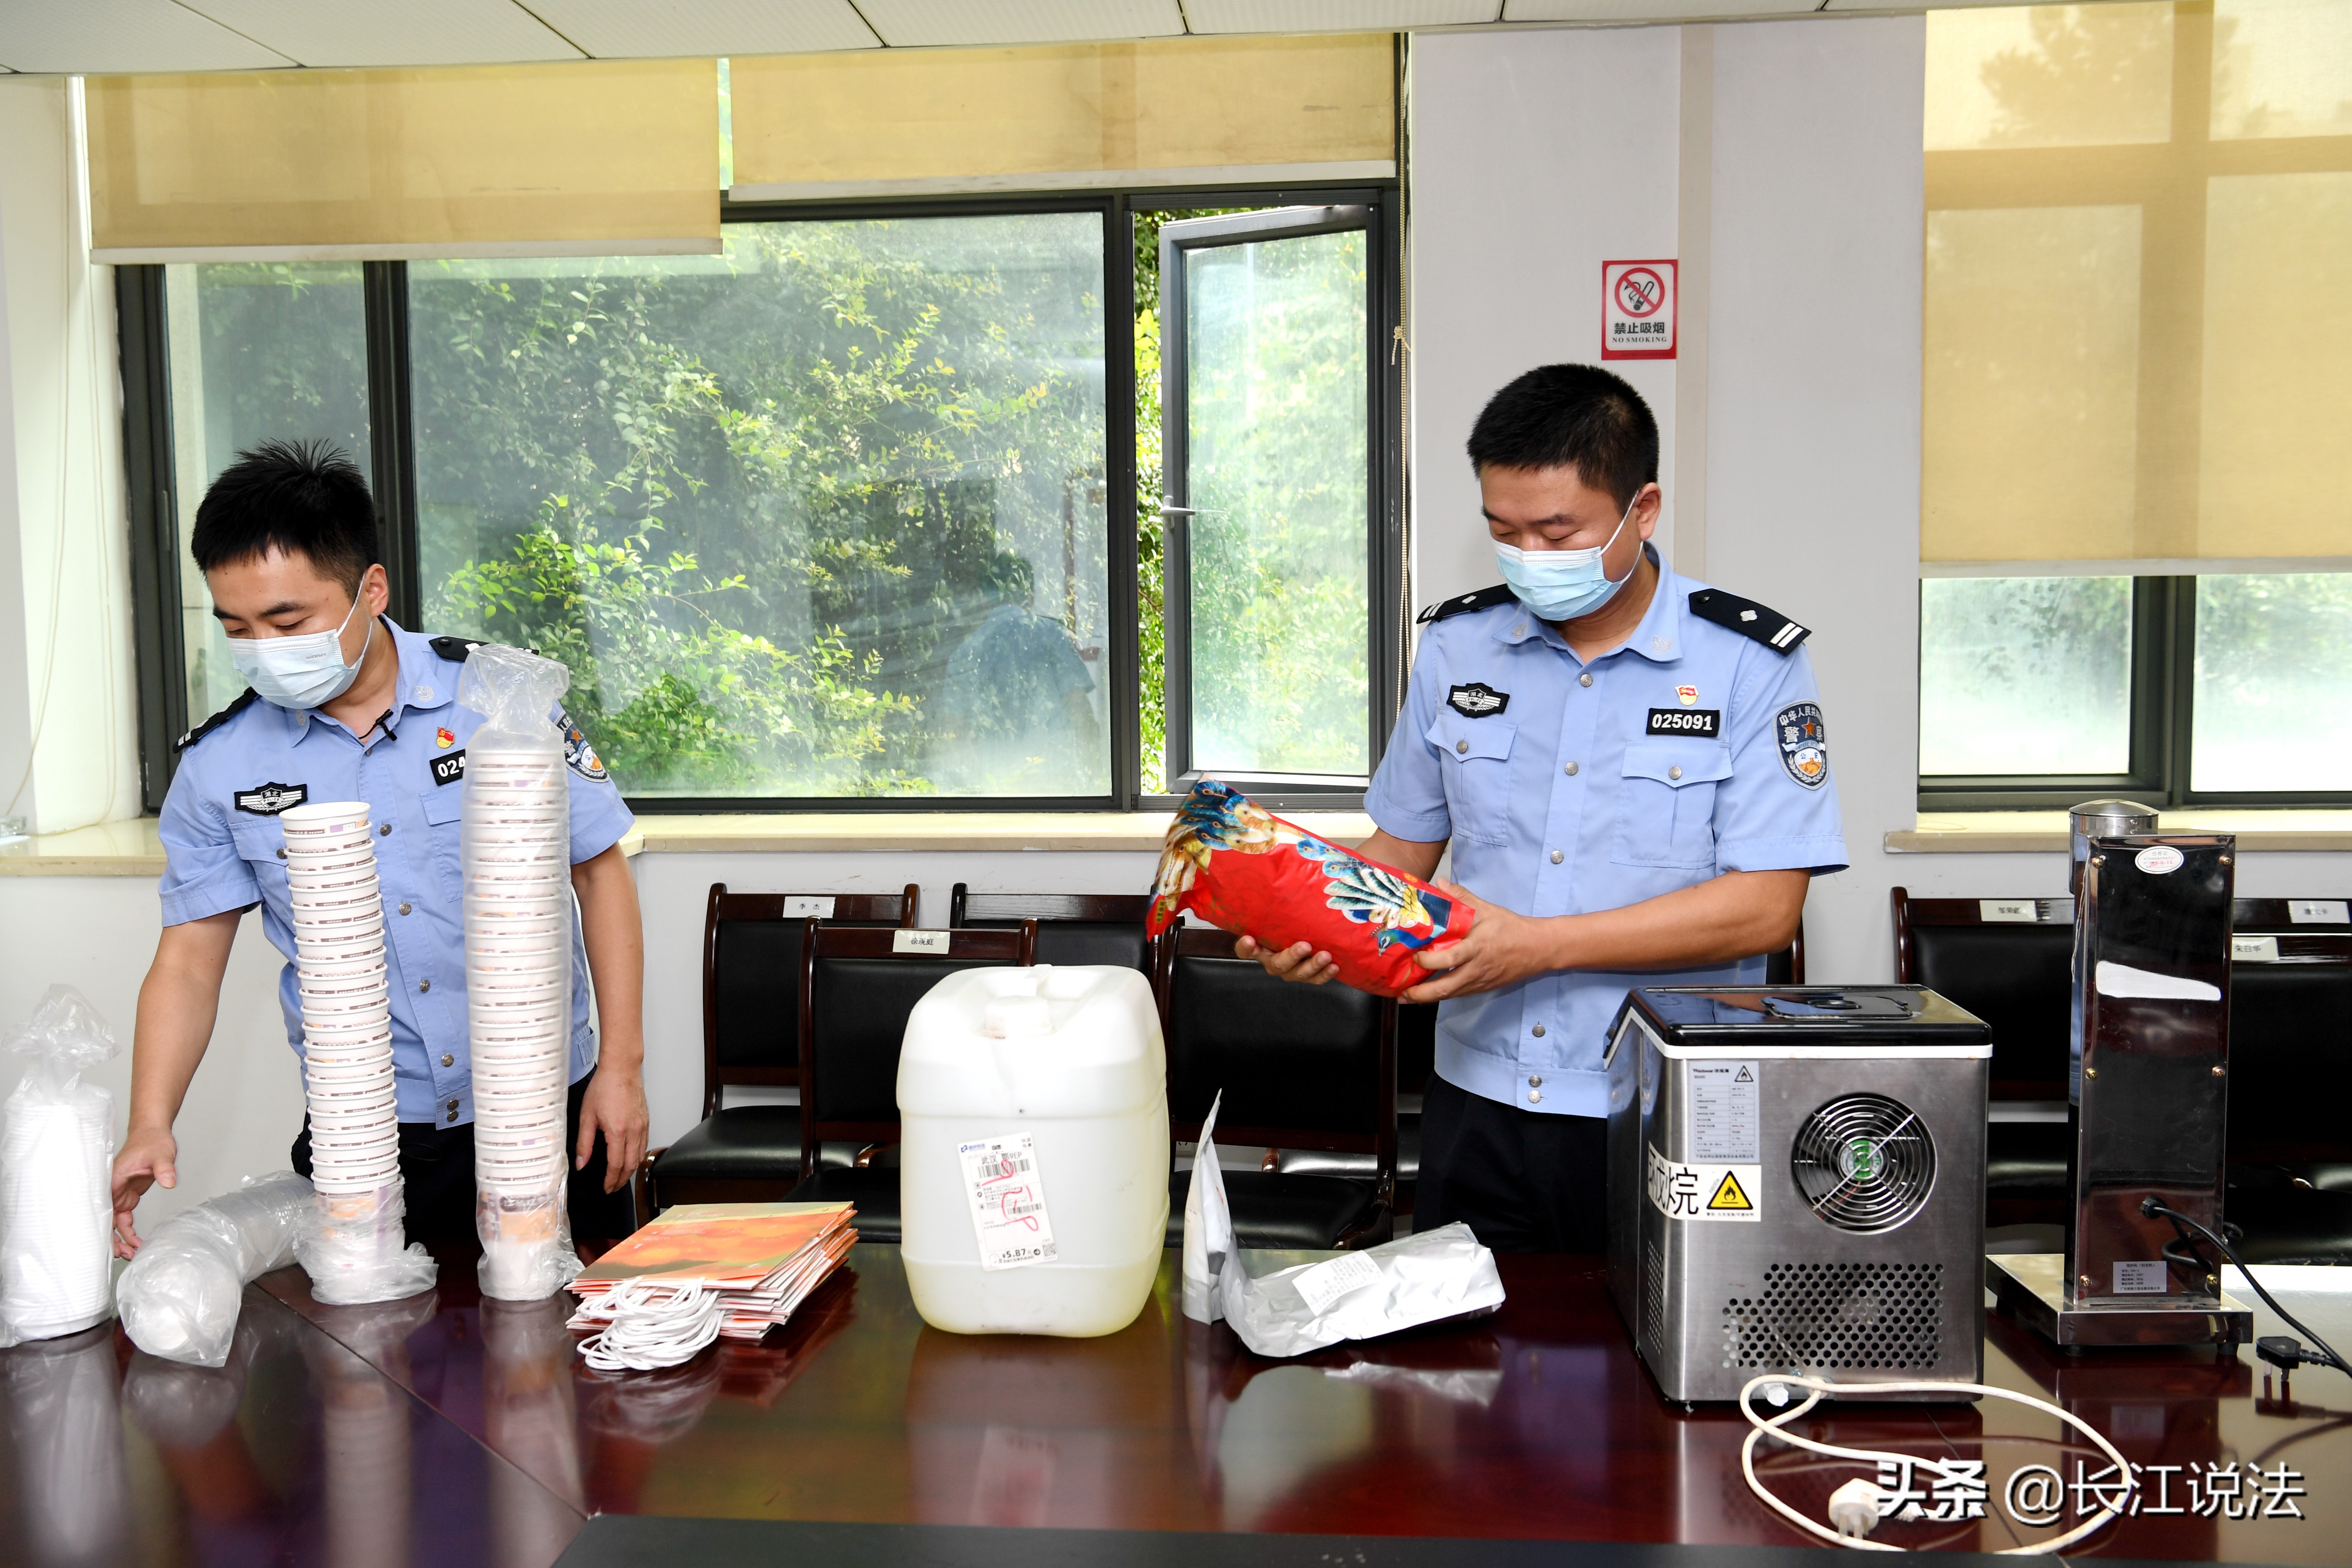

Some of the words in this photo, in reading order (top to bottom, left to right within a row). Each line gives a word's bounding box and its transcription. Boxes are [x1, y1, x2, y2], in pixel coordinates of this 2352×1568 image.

[1614, 322, 1665, 334] 禁止吸烟
[1652, 713, 1712, 730] 025091
[981, 1154, 998, 1165] 武汉
